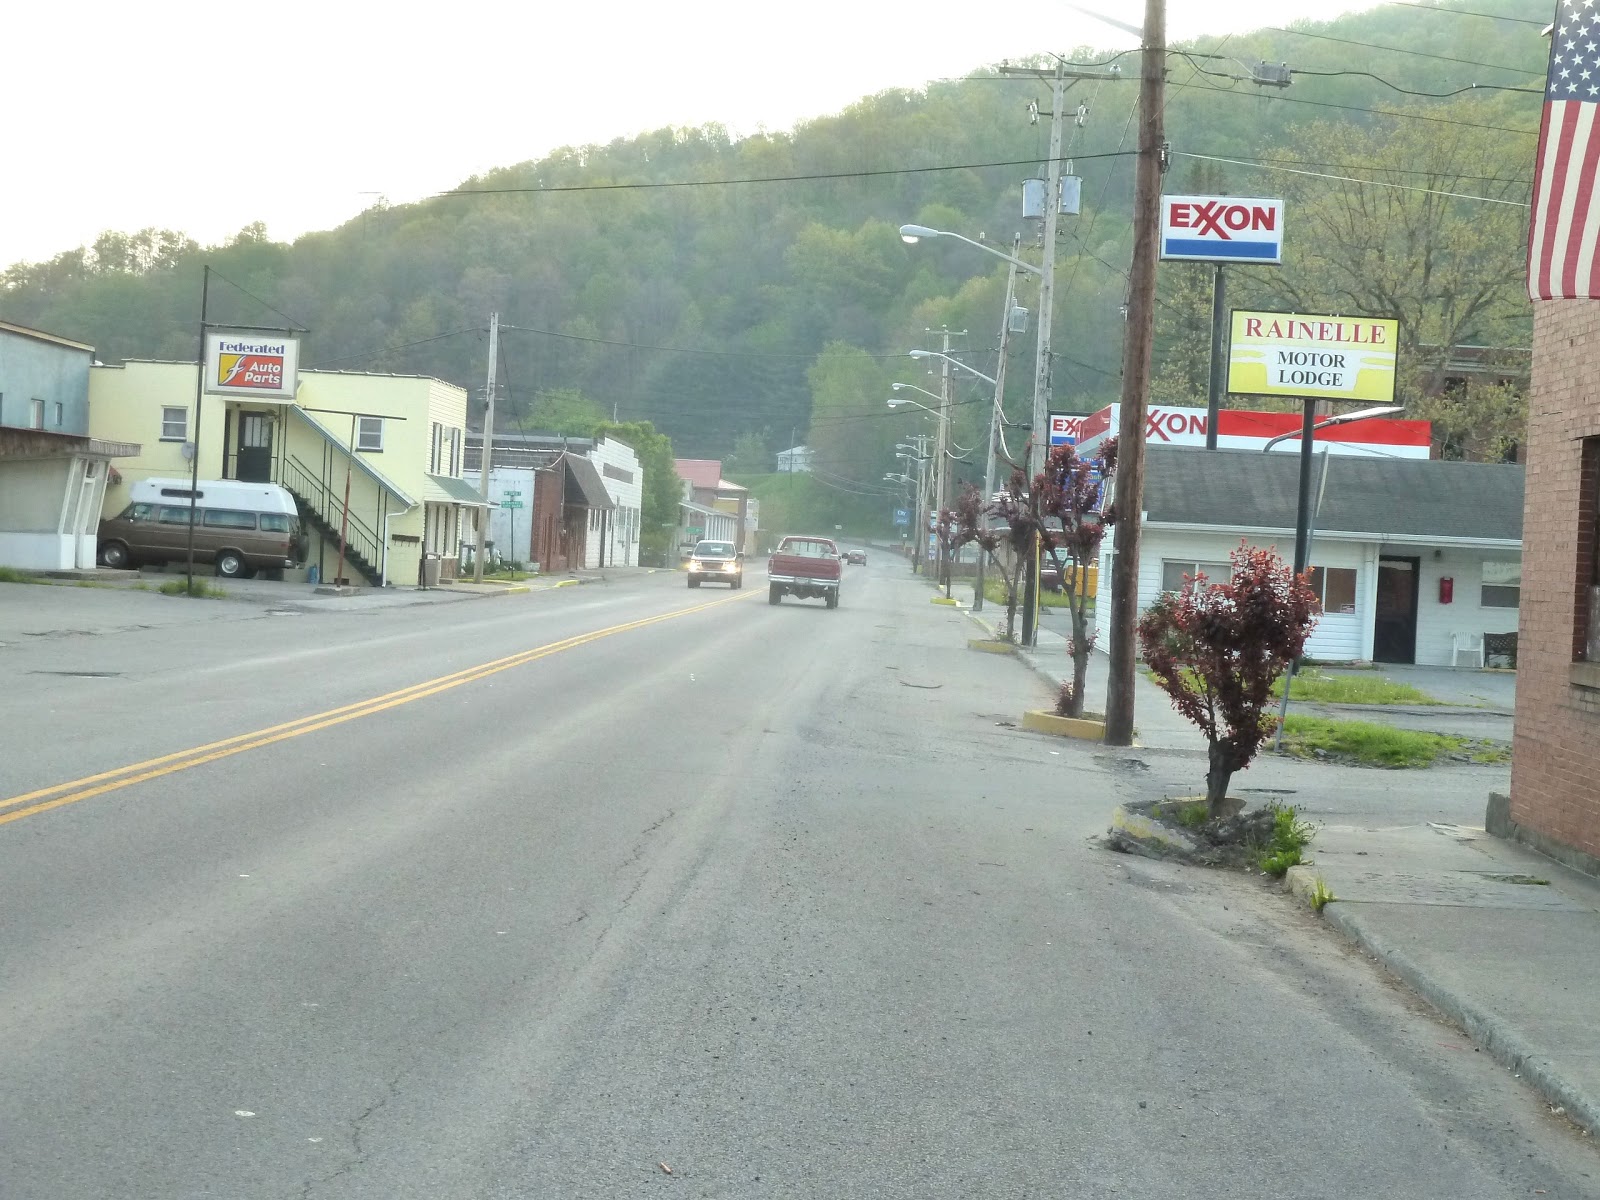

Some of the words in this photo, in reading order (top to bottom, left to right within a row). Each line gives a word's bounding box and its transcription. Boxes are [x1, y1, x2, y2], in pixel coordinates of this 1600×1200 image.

[1170, 201, 1276, 240] EXXON
[1244, 318, 1386, 344] RAINELLE
[219, 341, 285, 355] Federated
[248, 362, 281, 373] Auto
[1277, 351, 1345, 369] MOTOR
[244, 372, 281, 384] Parts
[1279, 369, 1344, 387] LODGE
[1053, 417, 1083, 436] EXX
[1145, 409, 1208, 442] XXON
